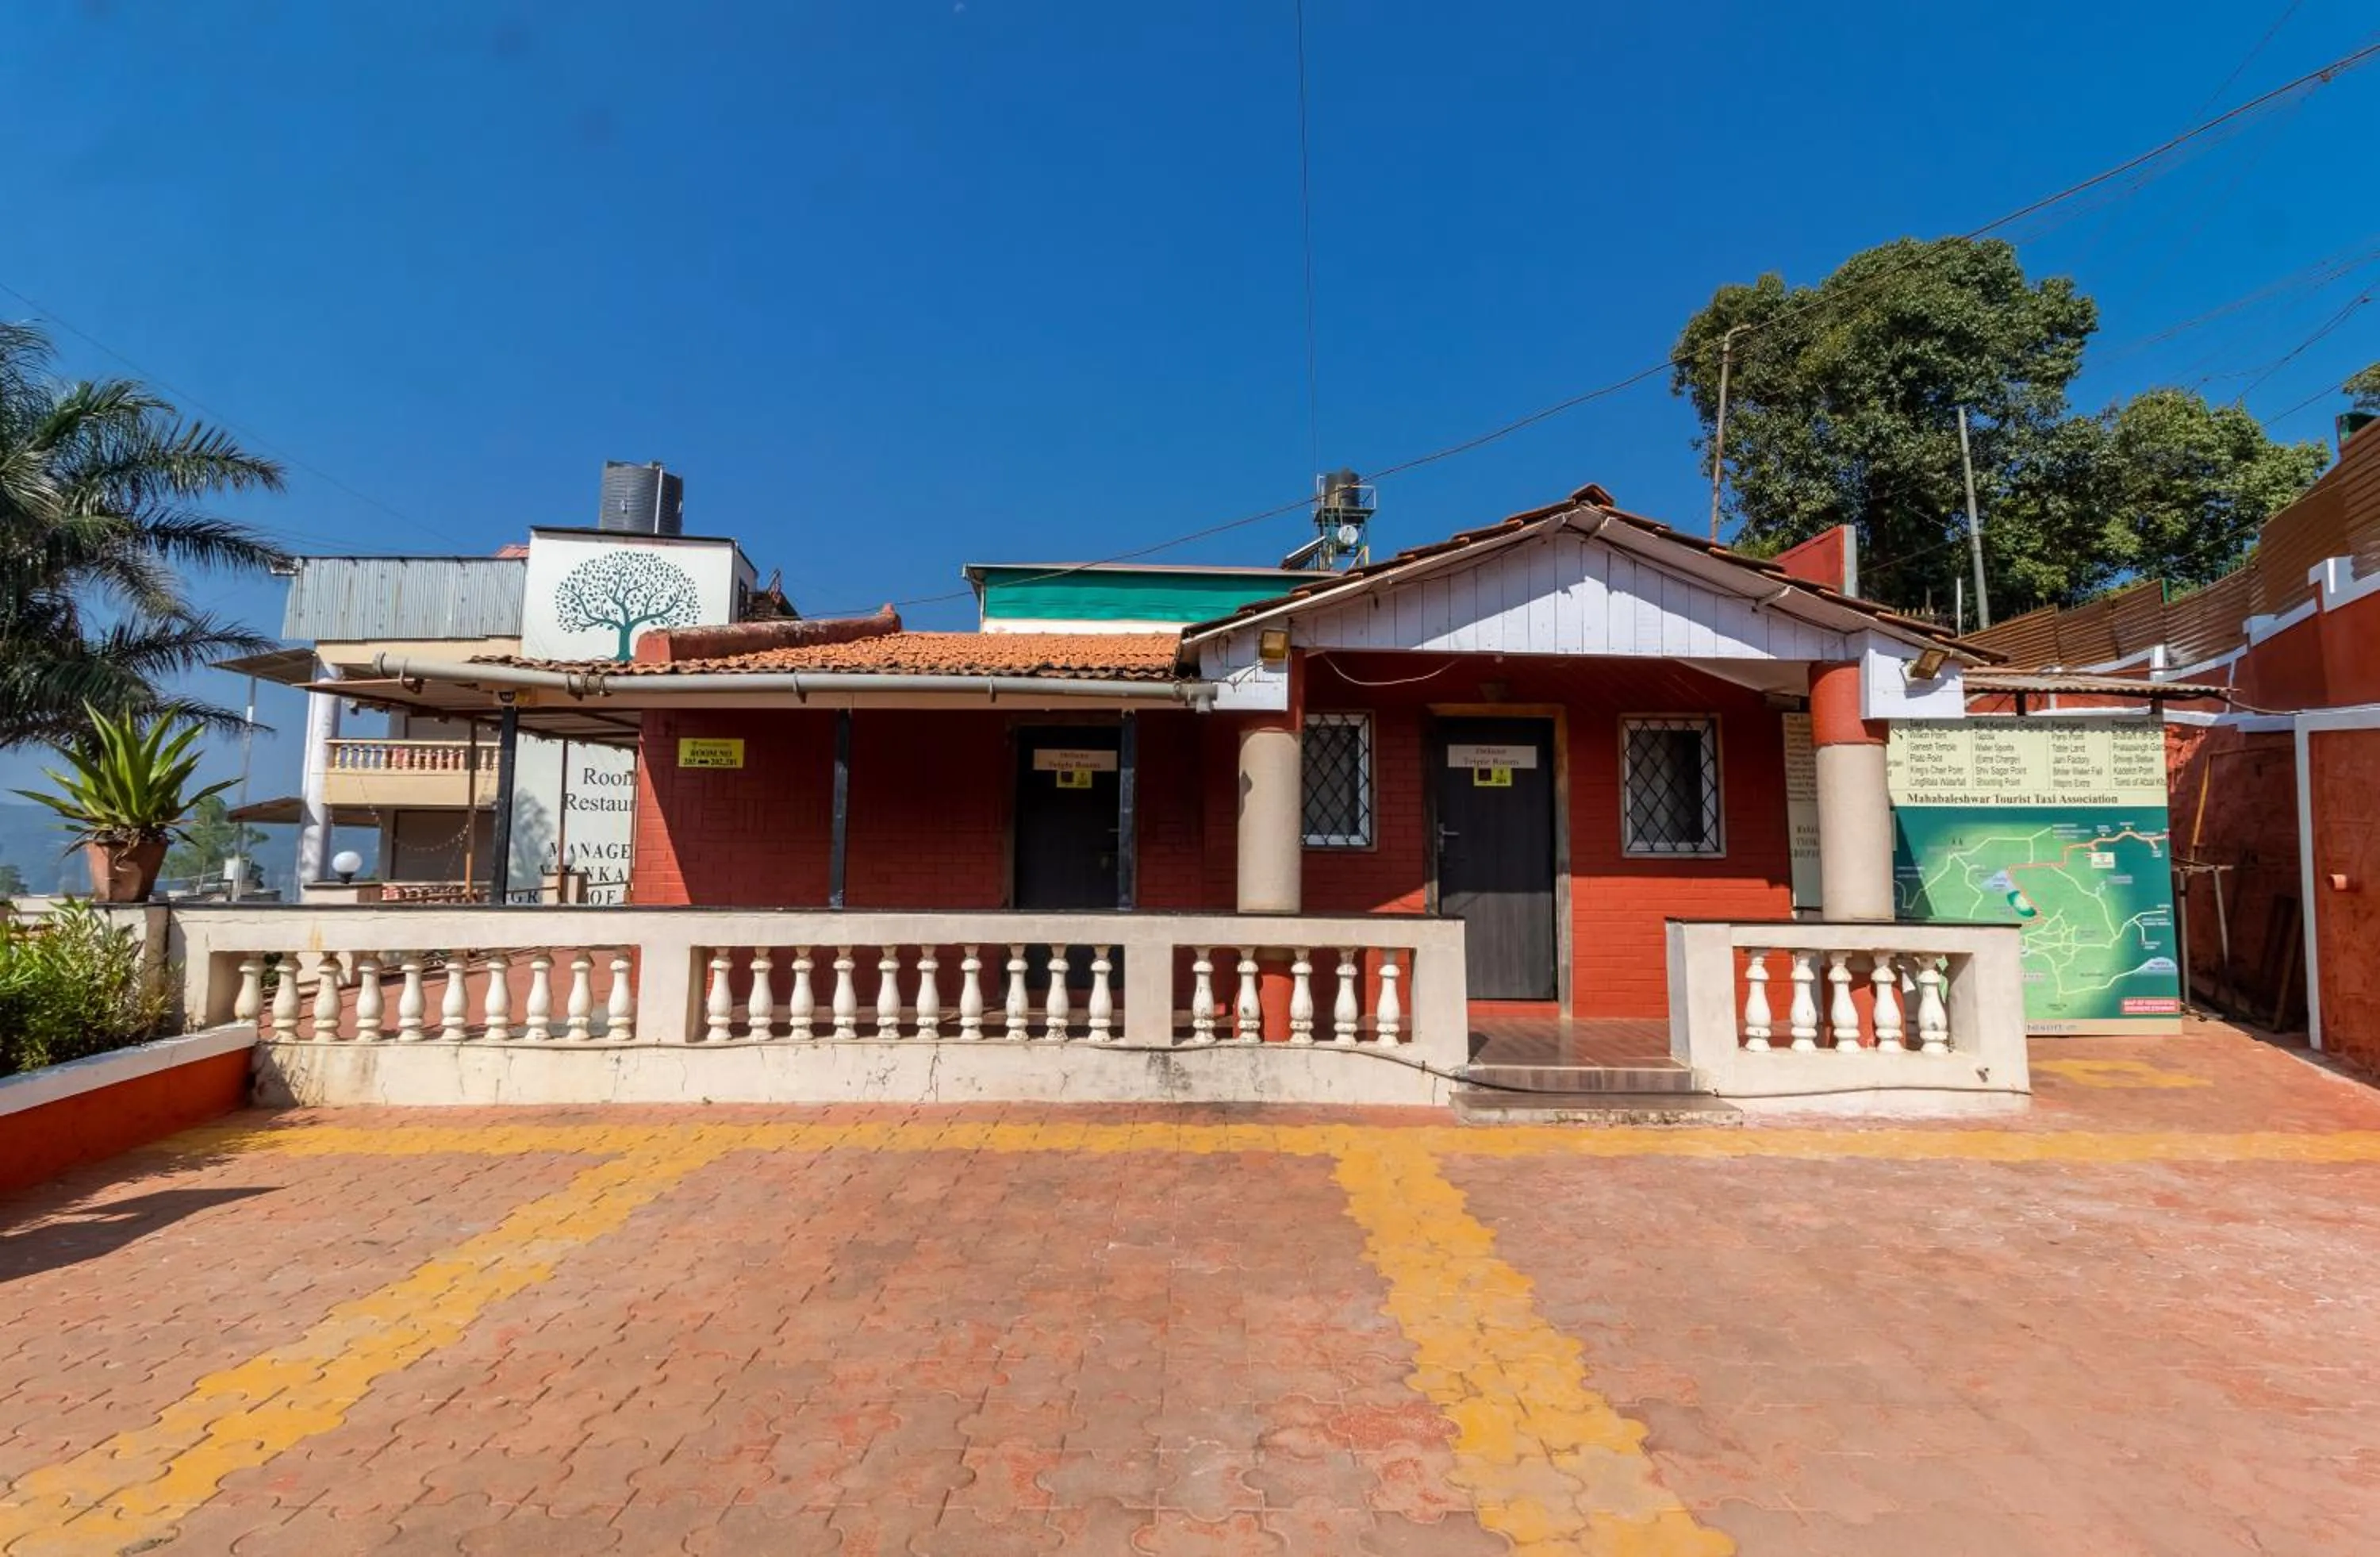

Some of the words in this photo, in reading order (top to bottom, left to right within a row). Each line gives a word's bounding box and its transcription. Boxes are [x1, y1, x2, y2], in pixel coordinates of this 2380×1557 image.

[1907, 793, 1991, 804] Mahabaleshwar
[1994, 794, 2031, 804] Tourist
[2034, 794, 2056, 804] Taxi
[2059, 794, 2118, 804] Association
